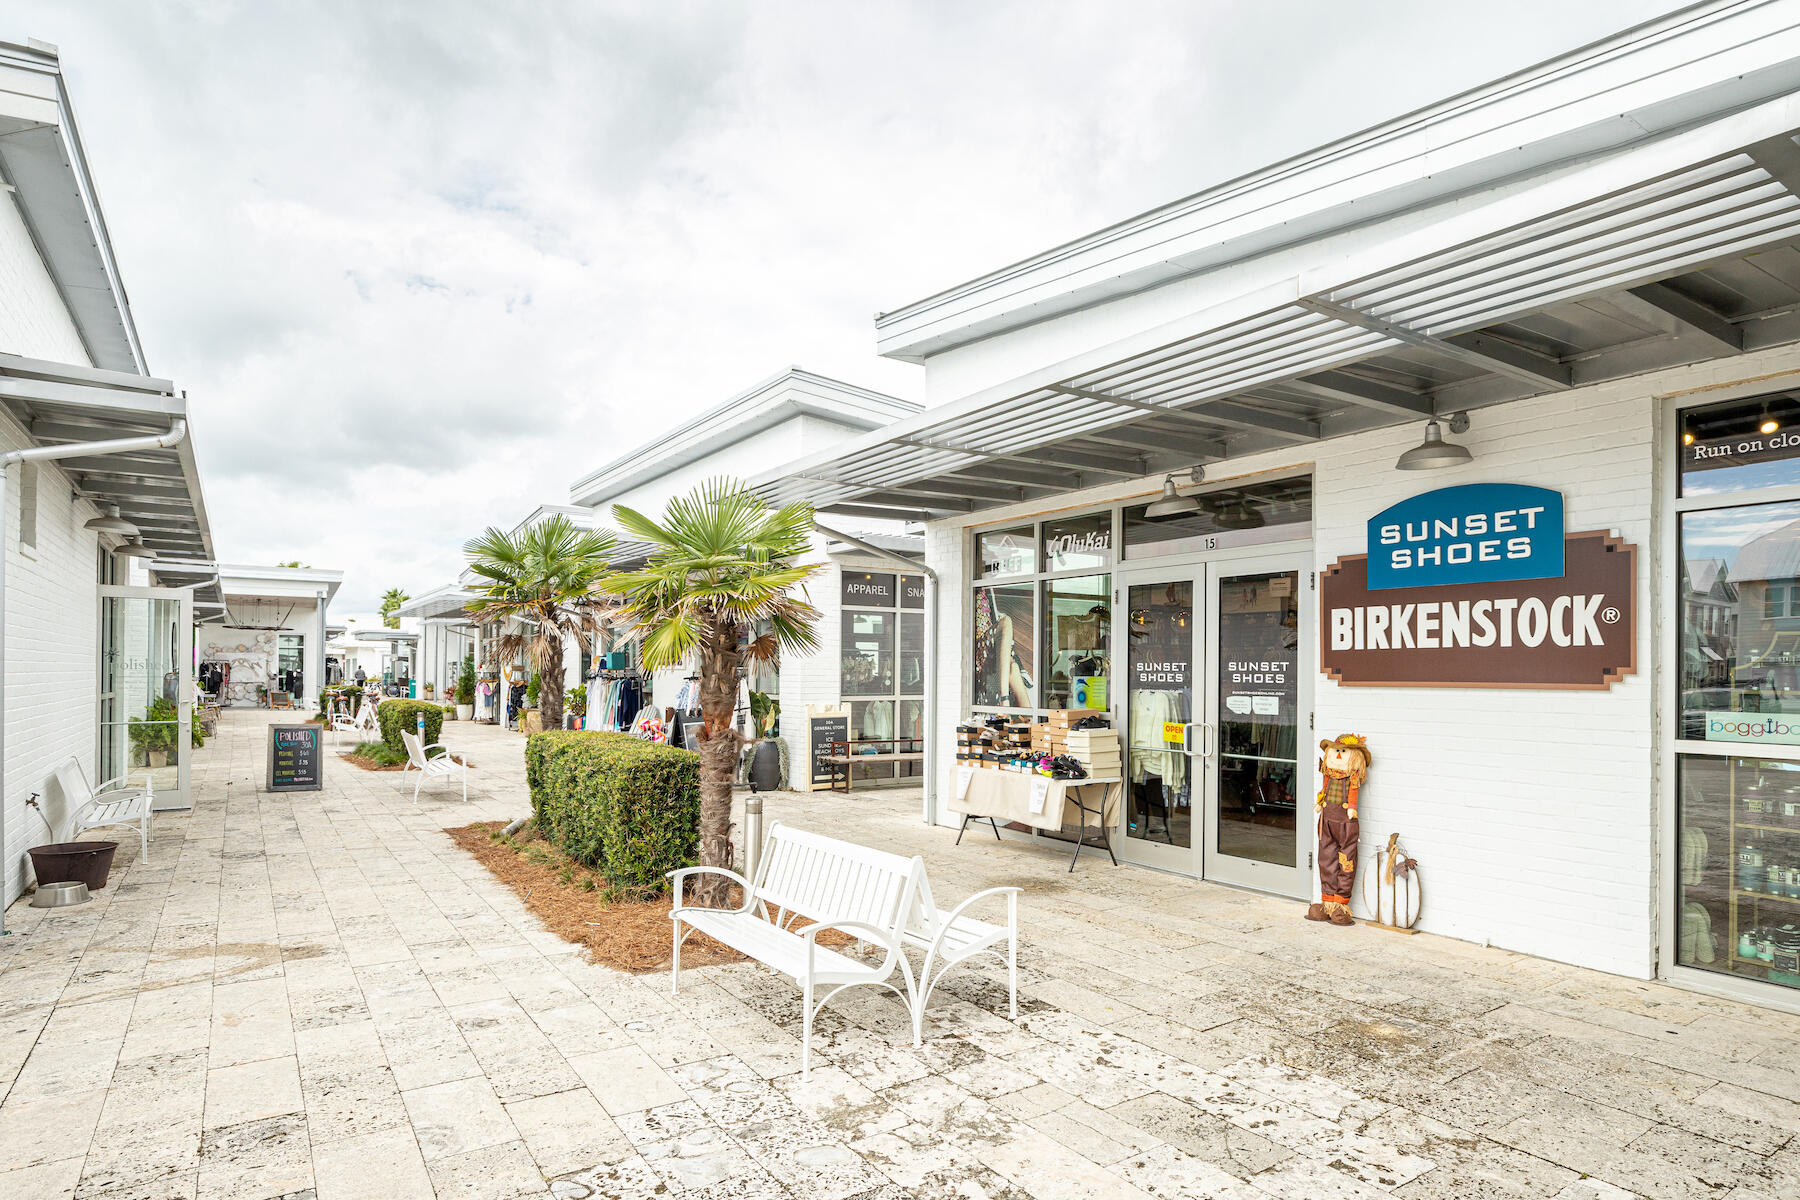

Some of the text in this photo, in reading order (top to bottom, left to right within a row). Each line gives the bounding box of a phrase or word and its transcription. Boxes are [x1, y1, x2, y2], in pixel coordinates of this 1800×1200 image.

[1693, 444, 1733, 461] Run
[1737, 439, 1764, 454] on
[1380, 506, 1545, 546] SUNSET
[1060, 530, 1110, 555] OluKai
[1204, 537, 1216, 550] 15
[1391, 536, 1532, 571] SHOES
[846, 583, 889, 597] APPAREL
[1136, 662, 1188, 672] SUNSET
[1228, 661, 1290, 672] SUNSET
[1139, 673, 1184, 682] SHOES
[1232, 673, 1286, 684] SHOES
[280, 731, 311, 741] POLISHED
[1165, 726, 1184, 734] OPEN
